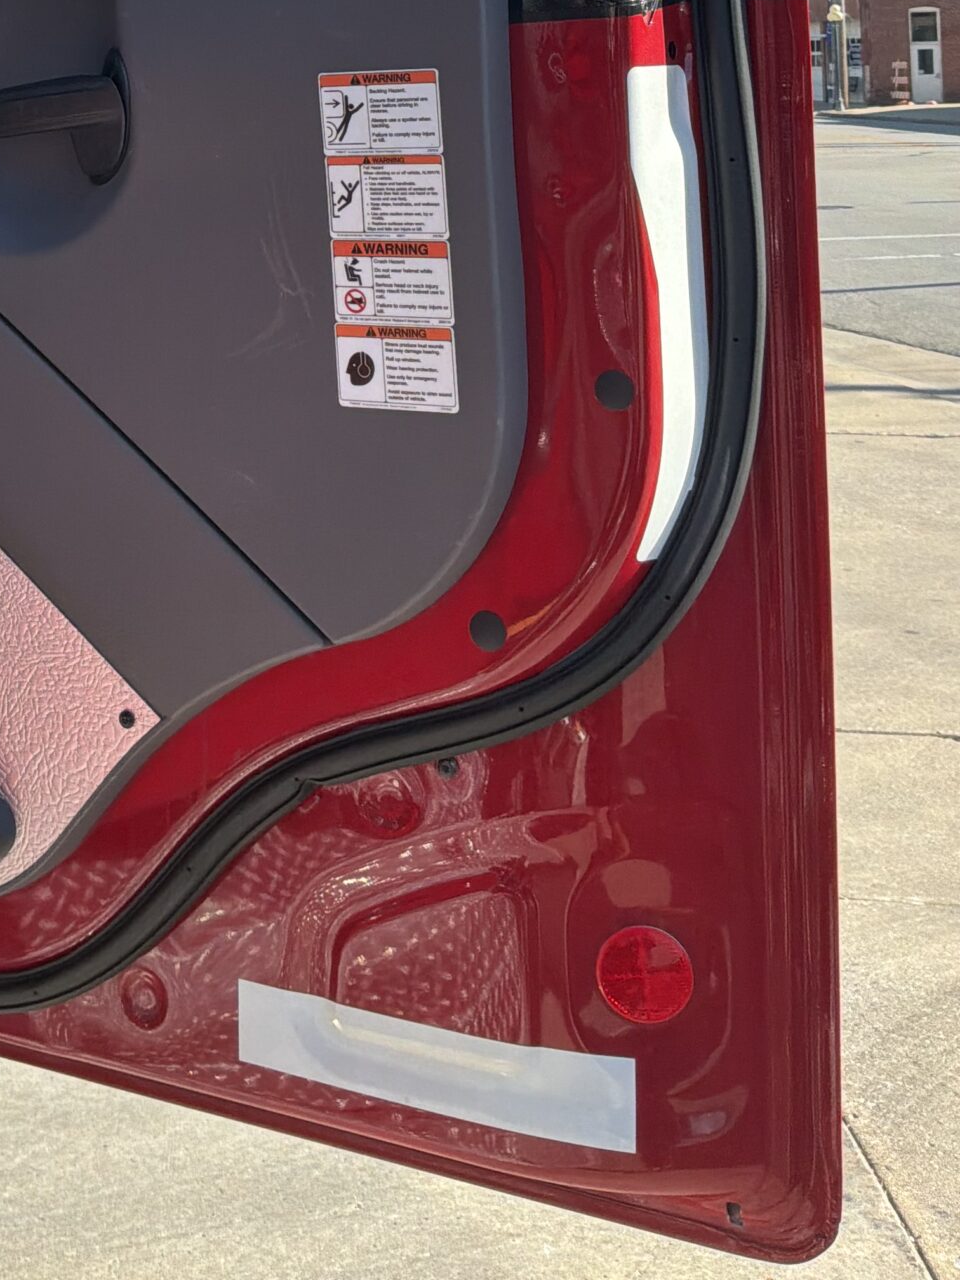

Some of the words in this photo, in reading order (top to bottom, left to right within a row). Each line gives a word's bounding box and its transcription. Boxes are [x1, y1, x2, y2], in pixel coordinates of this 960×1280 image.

[362, 73, 411, 83] WARNING
[363, 243, 429, 255] WARNING
[378, 328, 427, 338] WARNING
